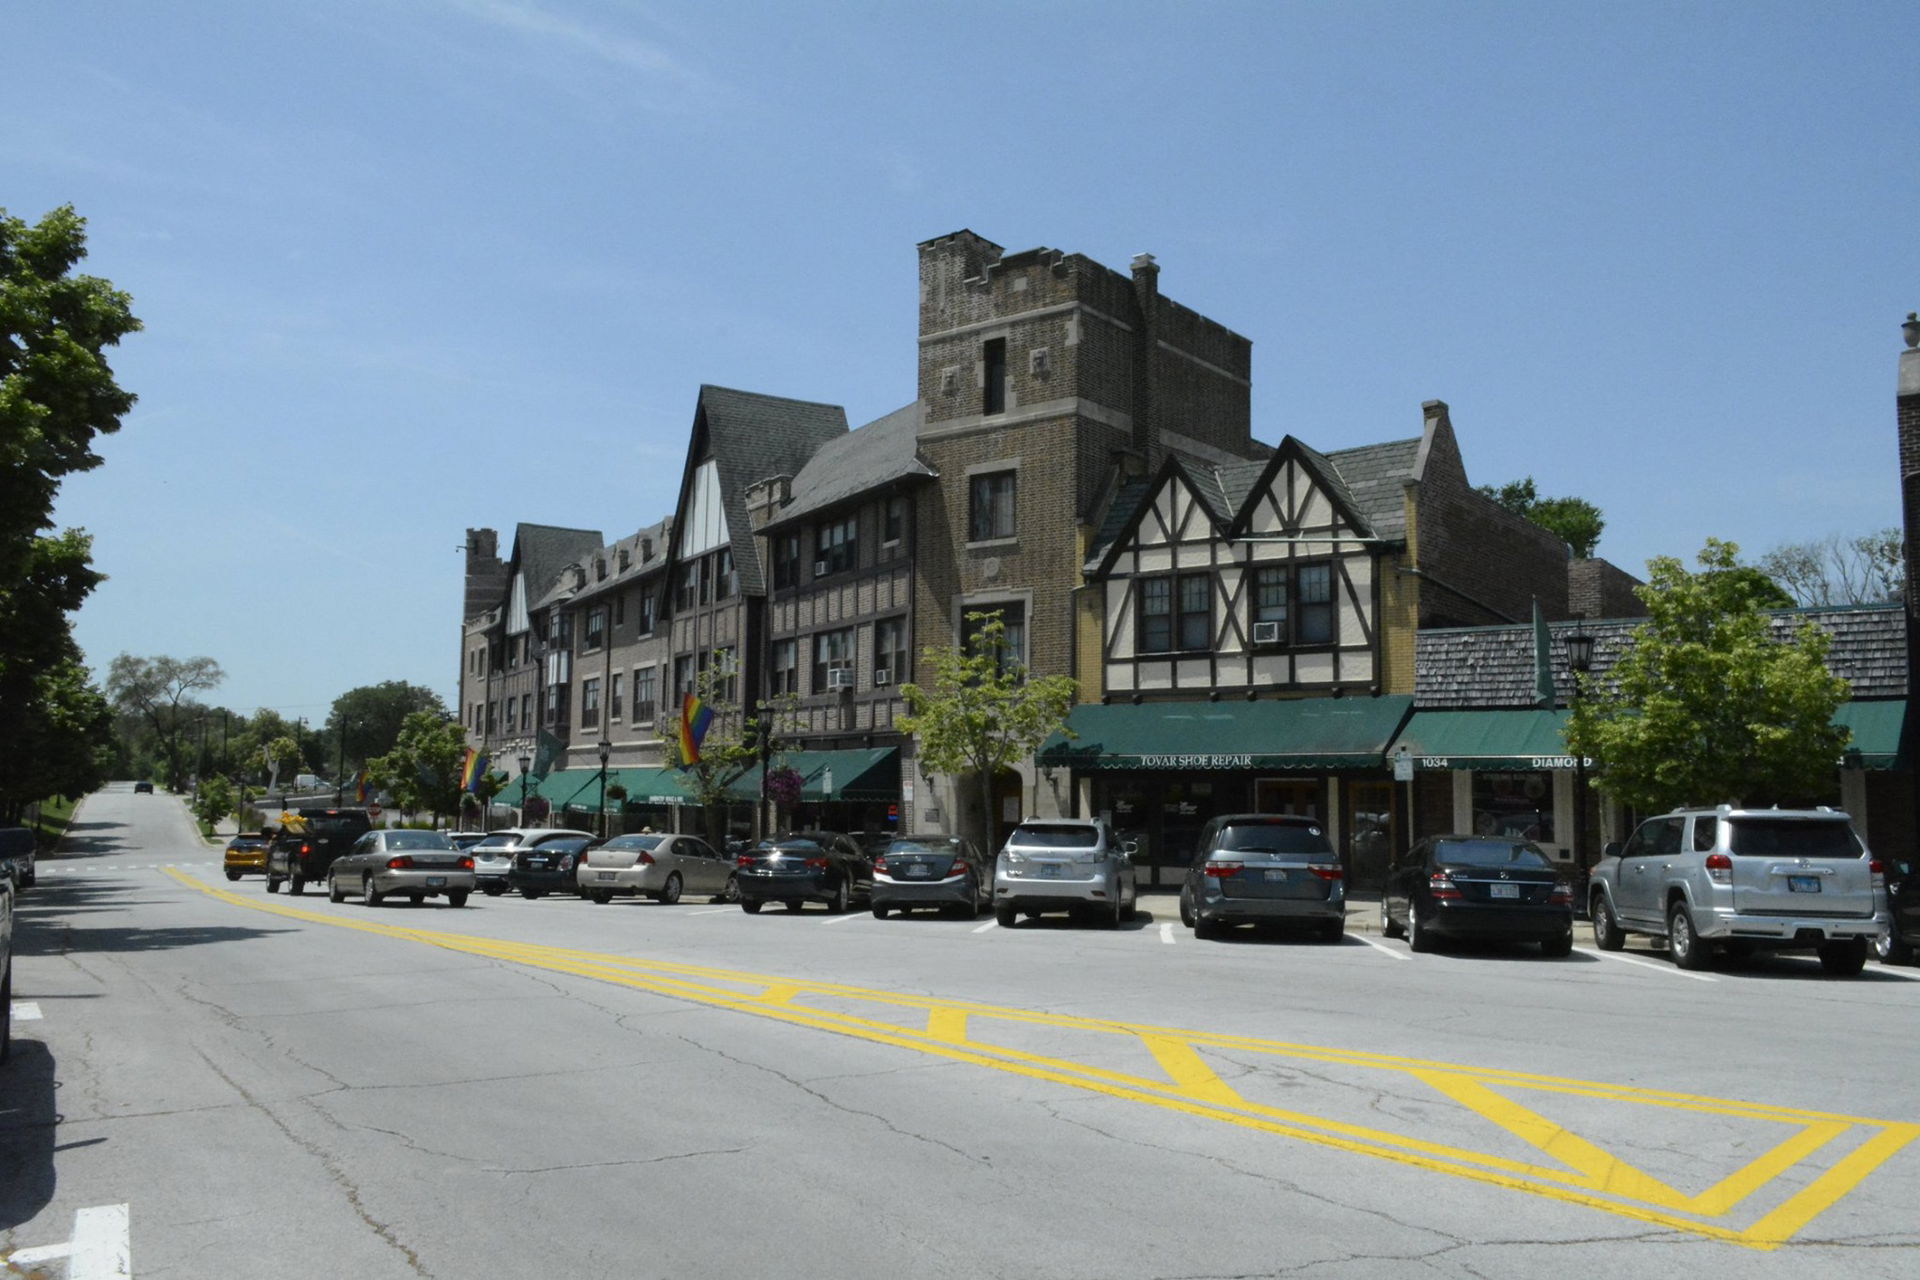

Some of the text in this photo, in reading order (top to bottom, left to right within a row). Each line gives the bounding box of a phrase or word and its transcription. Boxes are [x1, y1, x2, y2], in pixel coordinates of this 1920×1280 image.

[1140, 755, 1252, 766] TOVAR SHOE REPAIR
[1422, 758, 1448, 768] 1034
